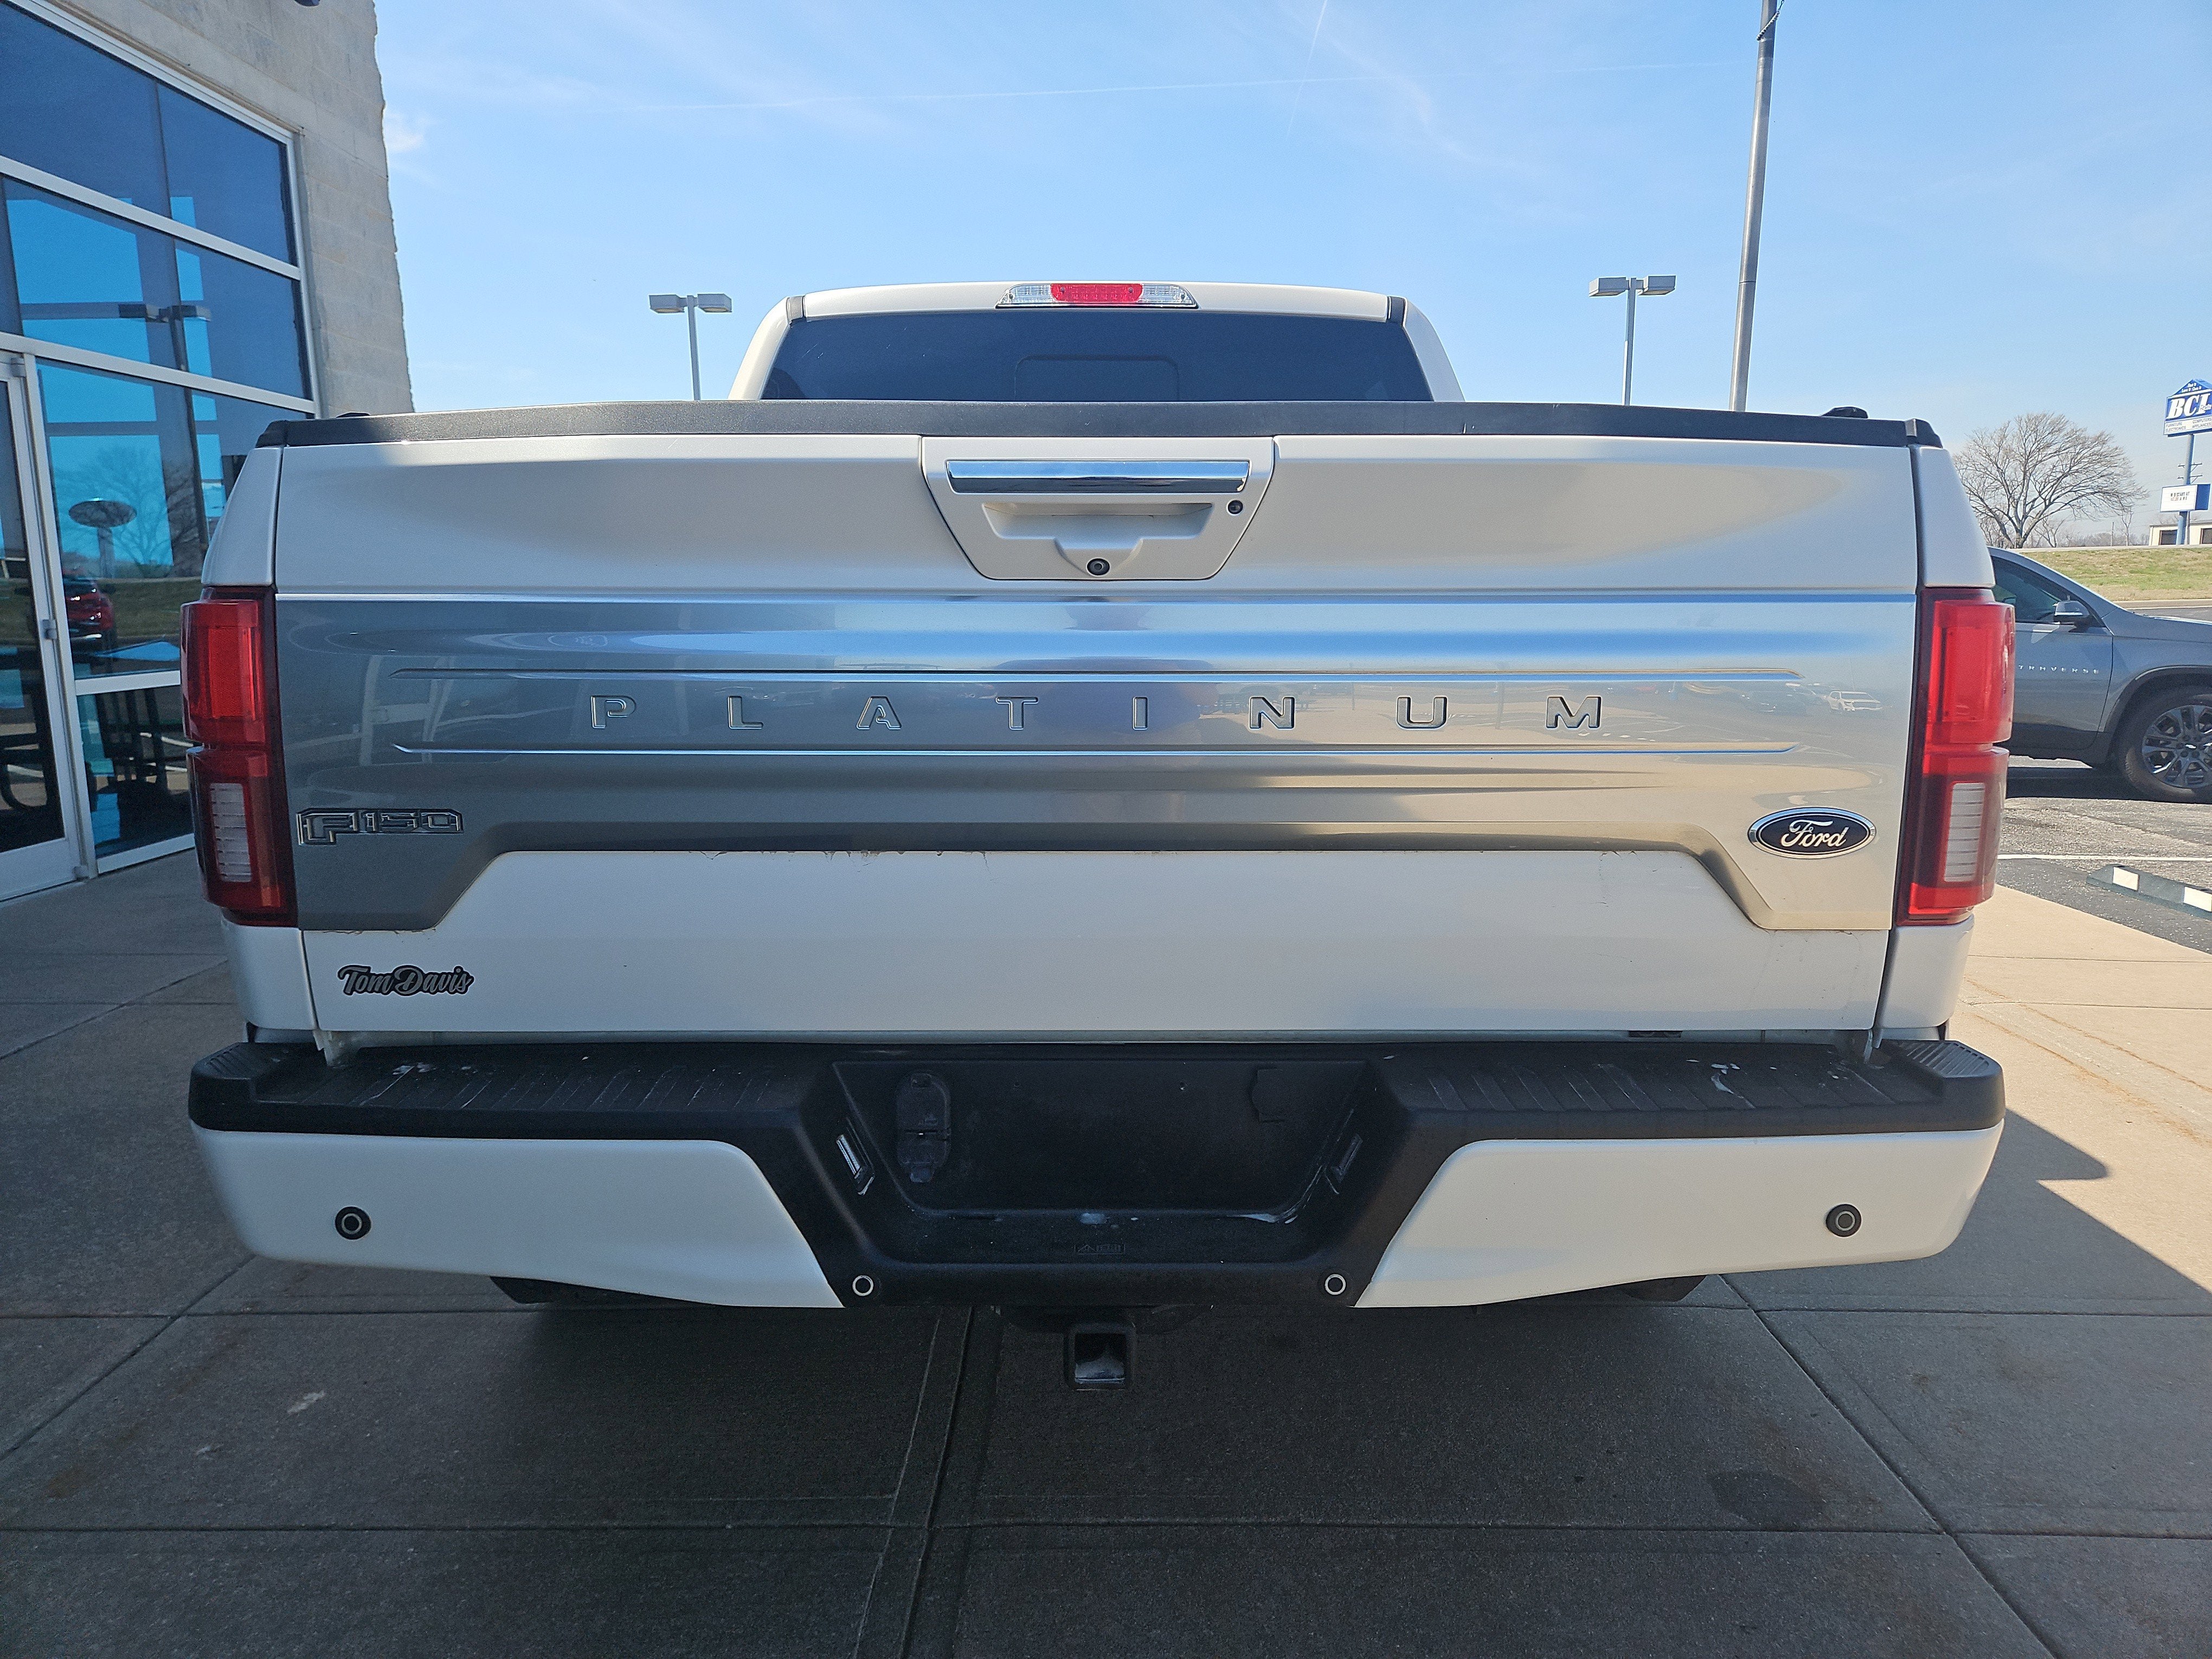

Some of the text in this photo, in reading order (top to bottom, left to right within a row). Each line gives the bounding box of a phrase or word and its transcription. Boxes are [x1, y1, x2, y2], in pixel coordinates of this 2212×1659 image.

[2018, 665, 2099, 674] TRAVERSE
[590, 695, 1602, 730] PLATINUM
[1780, 819, 1849, 847] Ford
[337, 964, 474, 996] Tom Davis
